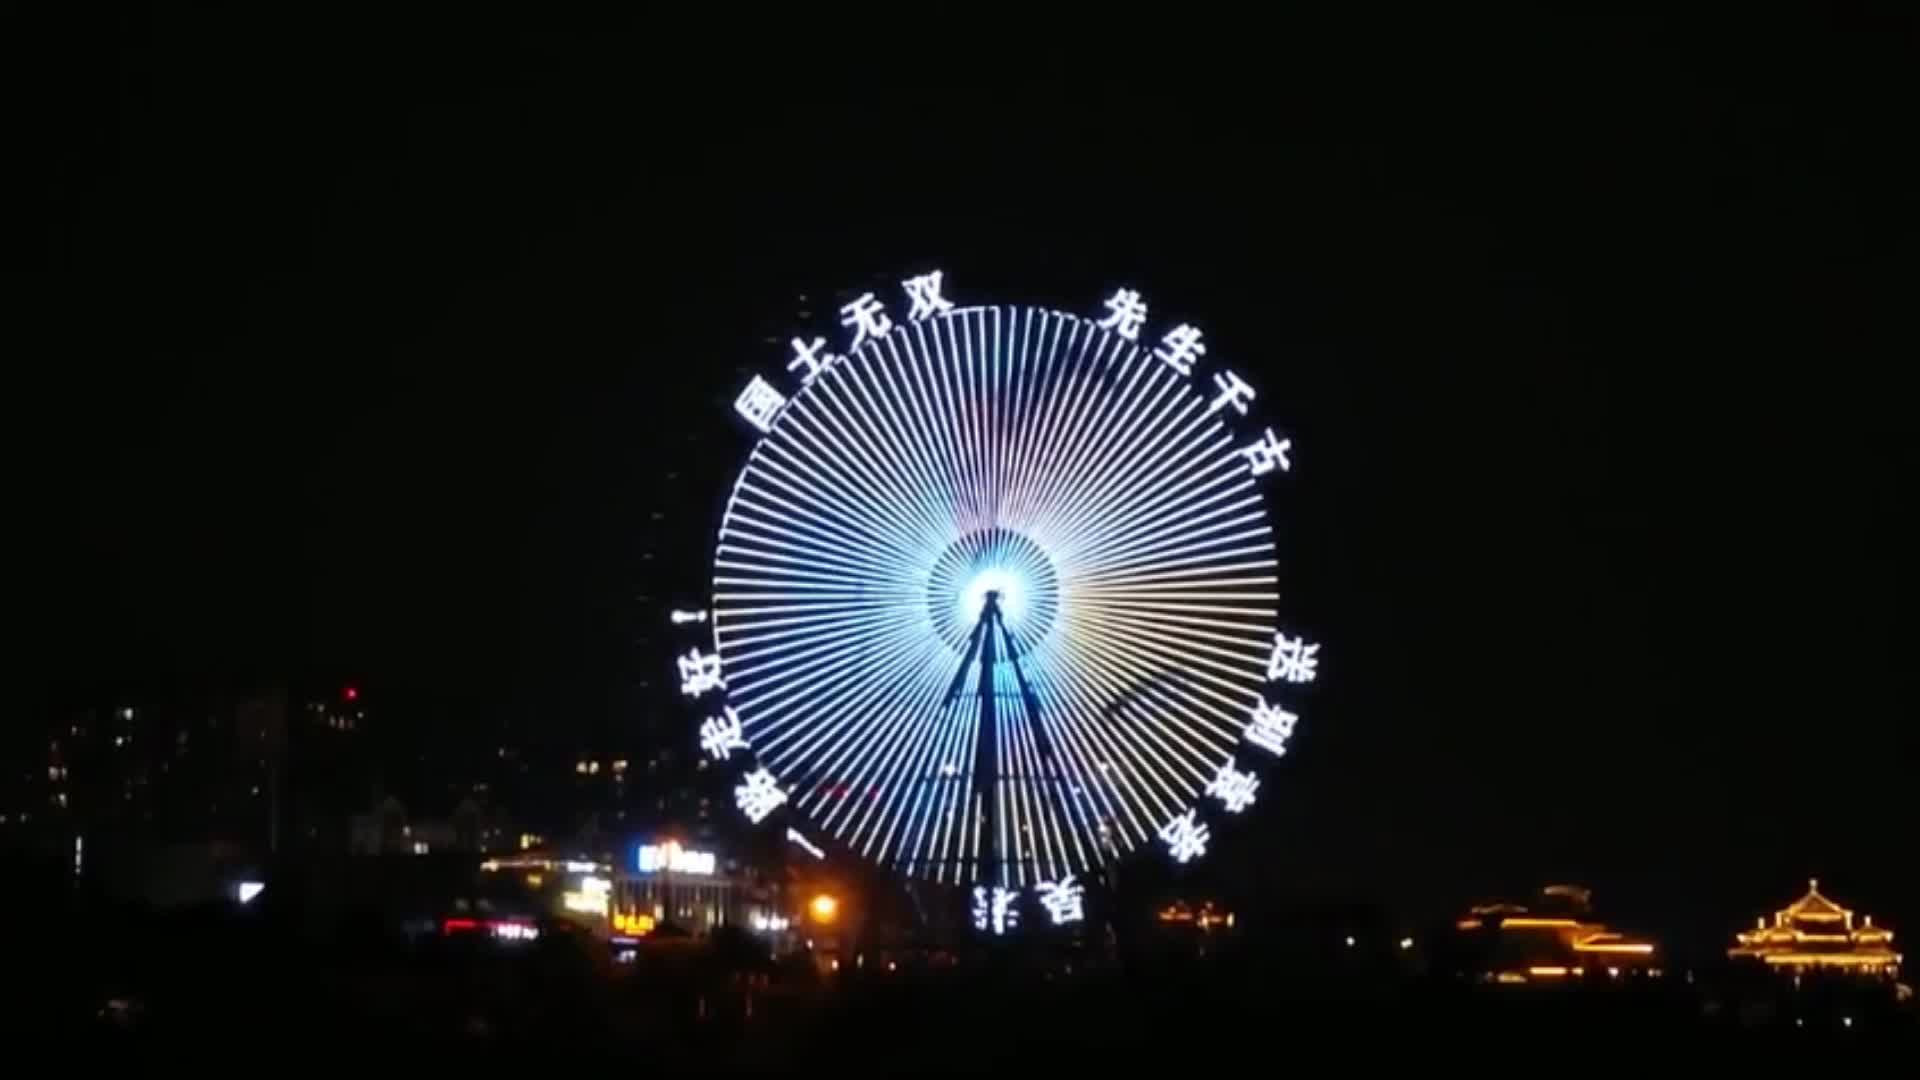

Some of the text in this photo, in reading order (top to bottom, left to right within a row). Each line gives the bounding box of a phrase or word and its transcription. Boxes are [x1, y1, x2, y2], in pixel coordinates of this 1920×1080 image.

[734, 269, 954, 434] 国士无双
[1097, 287, 1291, 476] 先生千古
